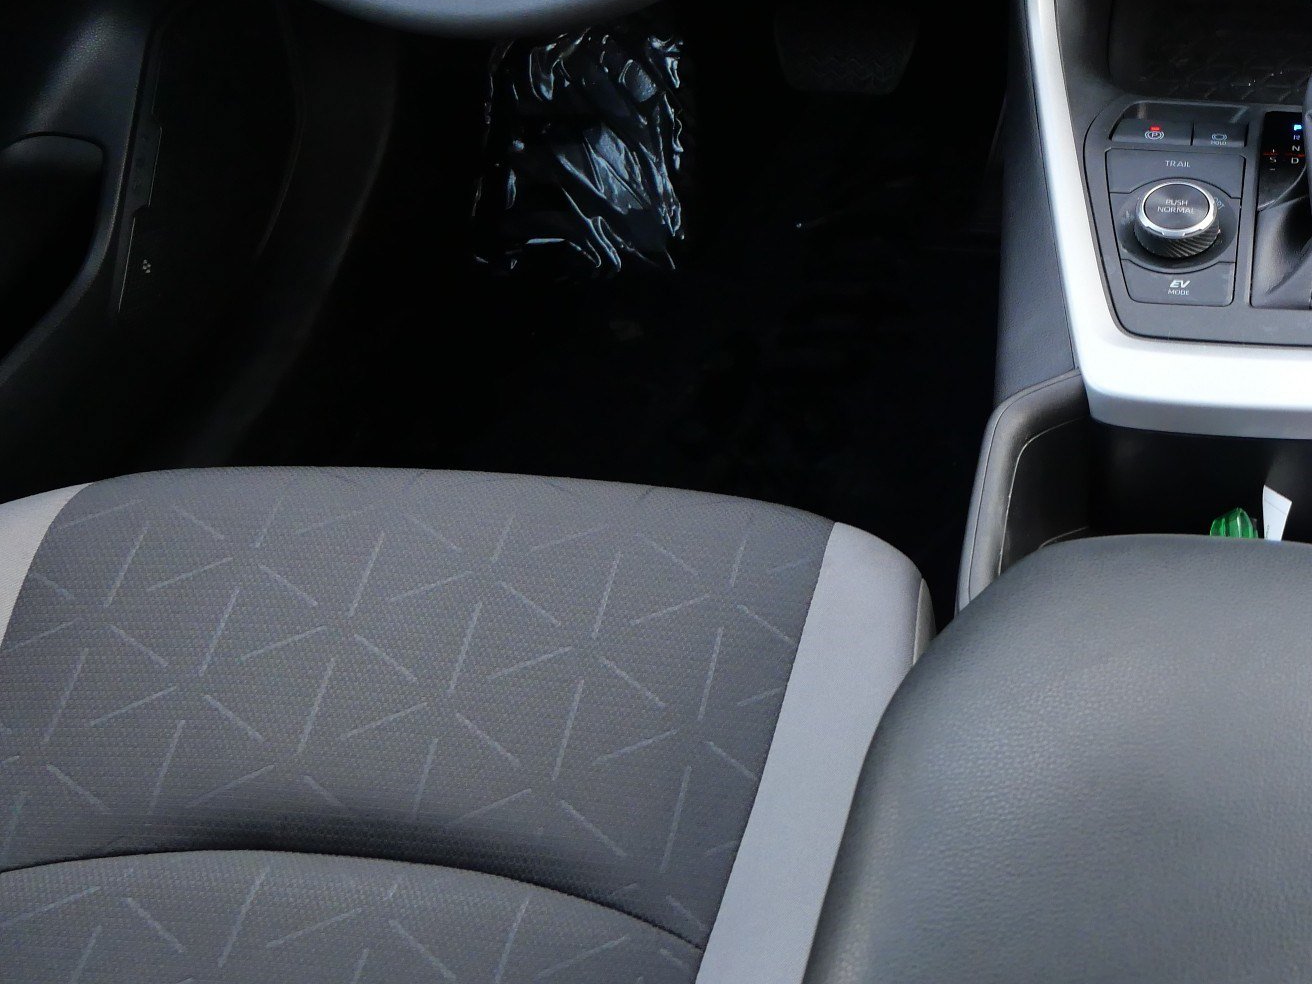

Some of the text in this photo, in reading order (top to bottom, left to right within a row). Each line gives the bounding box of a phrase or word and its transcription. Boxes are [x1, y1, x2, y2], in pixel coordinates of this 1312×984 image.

[1165, 160, 1190, 168] TRAIL
[1157, 206, 1195, 215] NORMAL
[1169, 279, 1191, 288] EV
[1167, 288, 1190, 296] MODE
